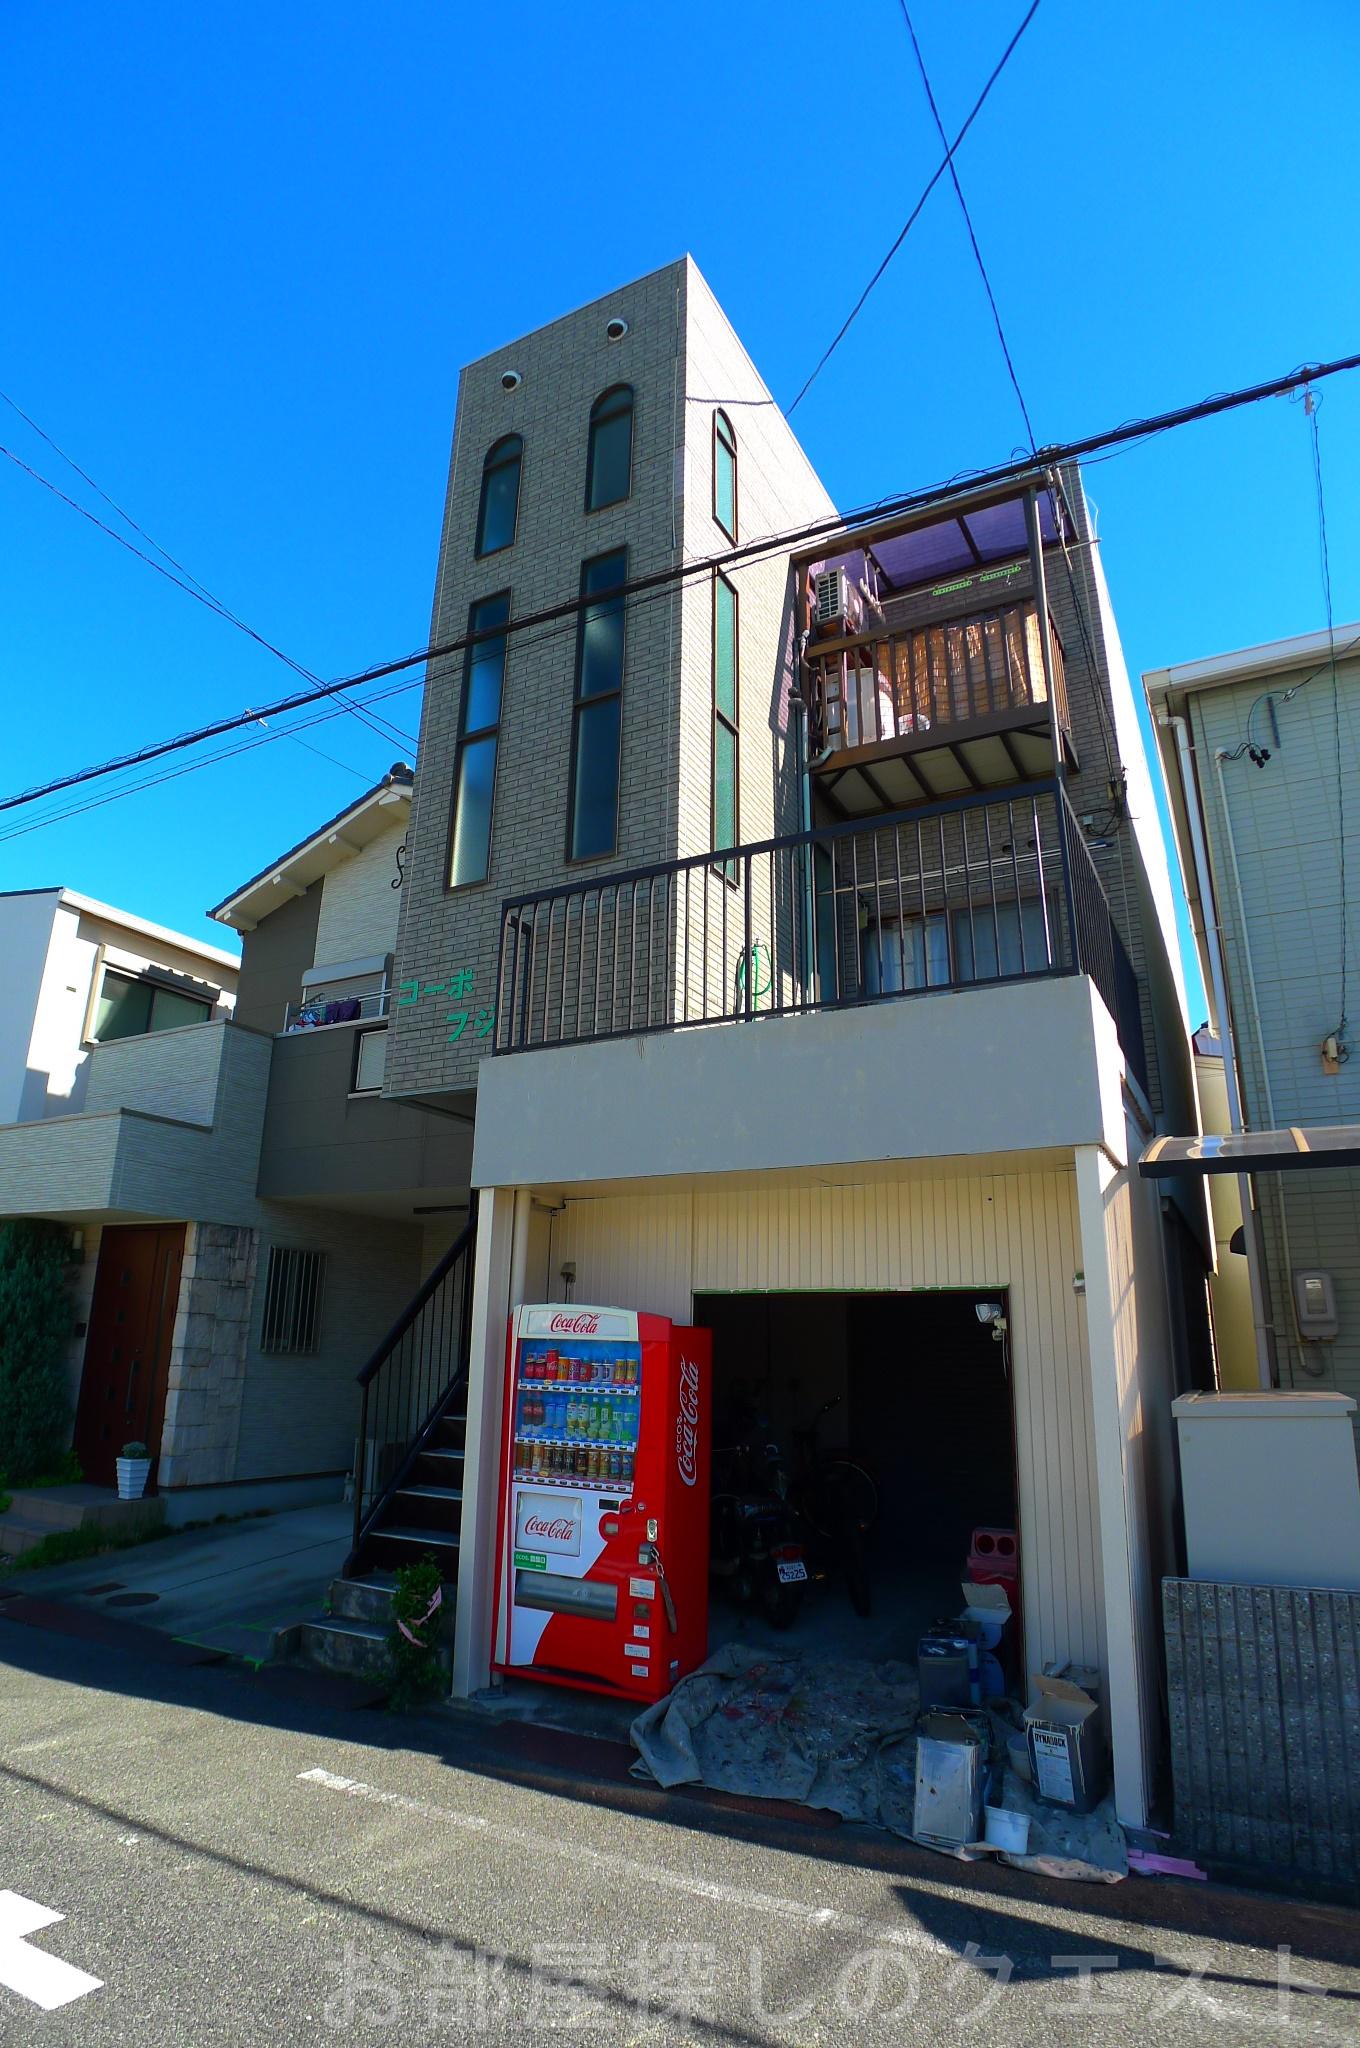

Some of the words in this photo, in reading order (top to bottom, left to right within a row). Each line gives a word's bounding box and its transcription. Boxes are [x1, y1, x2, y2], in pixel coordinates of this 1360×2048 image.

[397, 967, 473, 1006] コーポ
[447, 1004, 496, 1043] フジ
